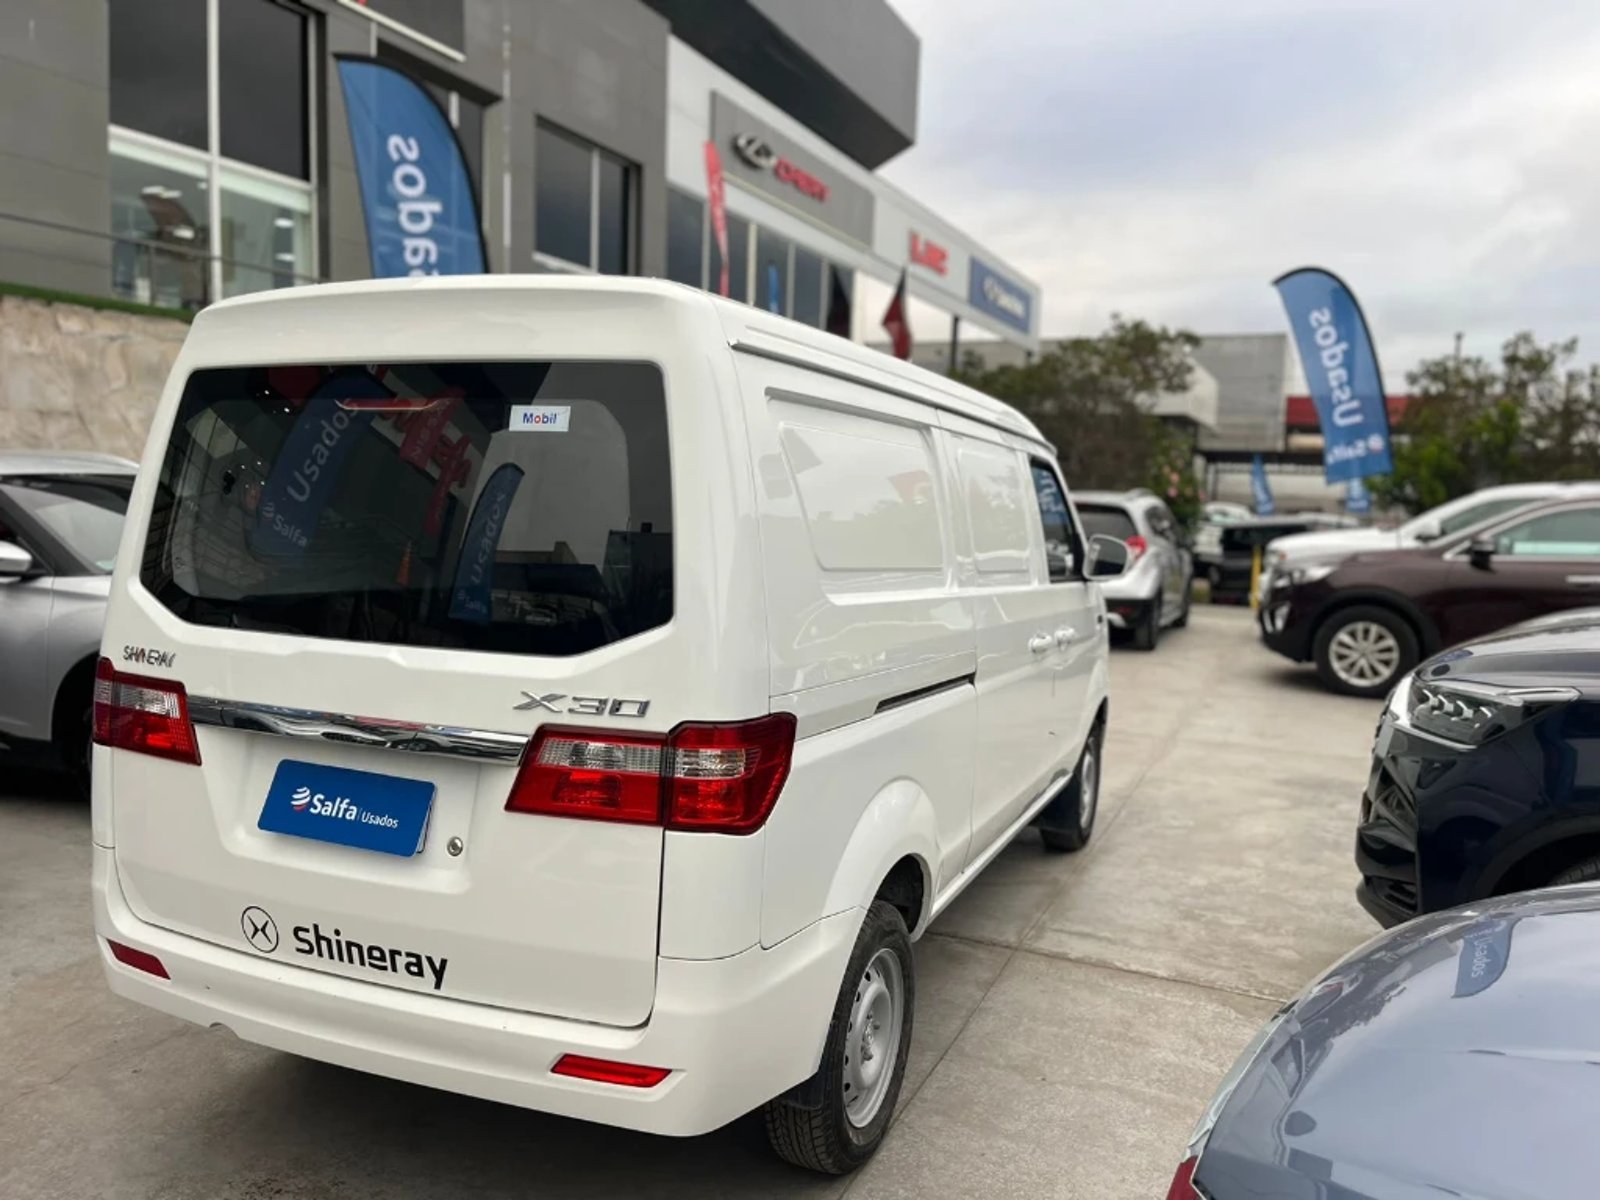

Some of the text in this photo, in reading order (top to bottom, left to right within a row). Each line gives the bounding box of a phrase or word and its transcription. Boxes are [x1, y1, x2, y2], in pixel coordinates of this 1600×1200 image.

[522, 412, 557, 424] Mobil
[286, 398, 359, 502] Usados
[273, 514, 308, 547] Salfa
[512, 690, 650, 717] X30
[309, 793, 399, 829] Salfa Usados
[292, 922, 448, 990] Shineray
